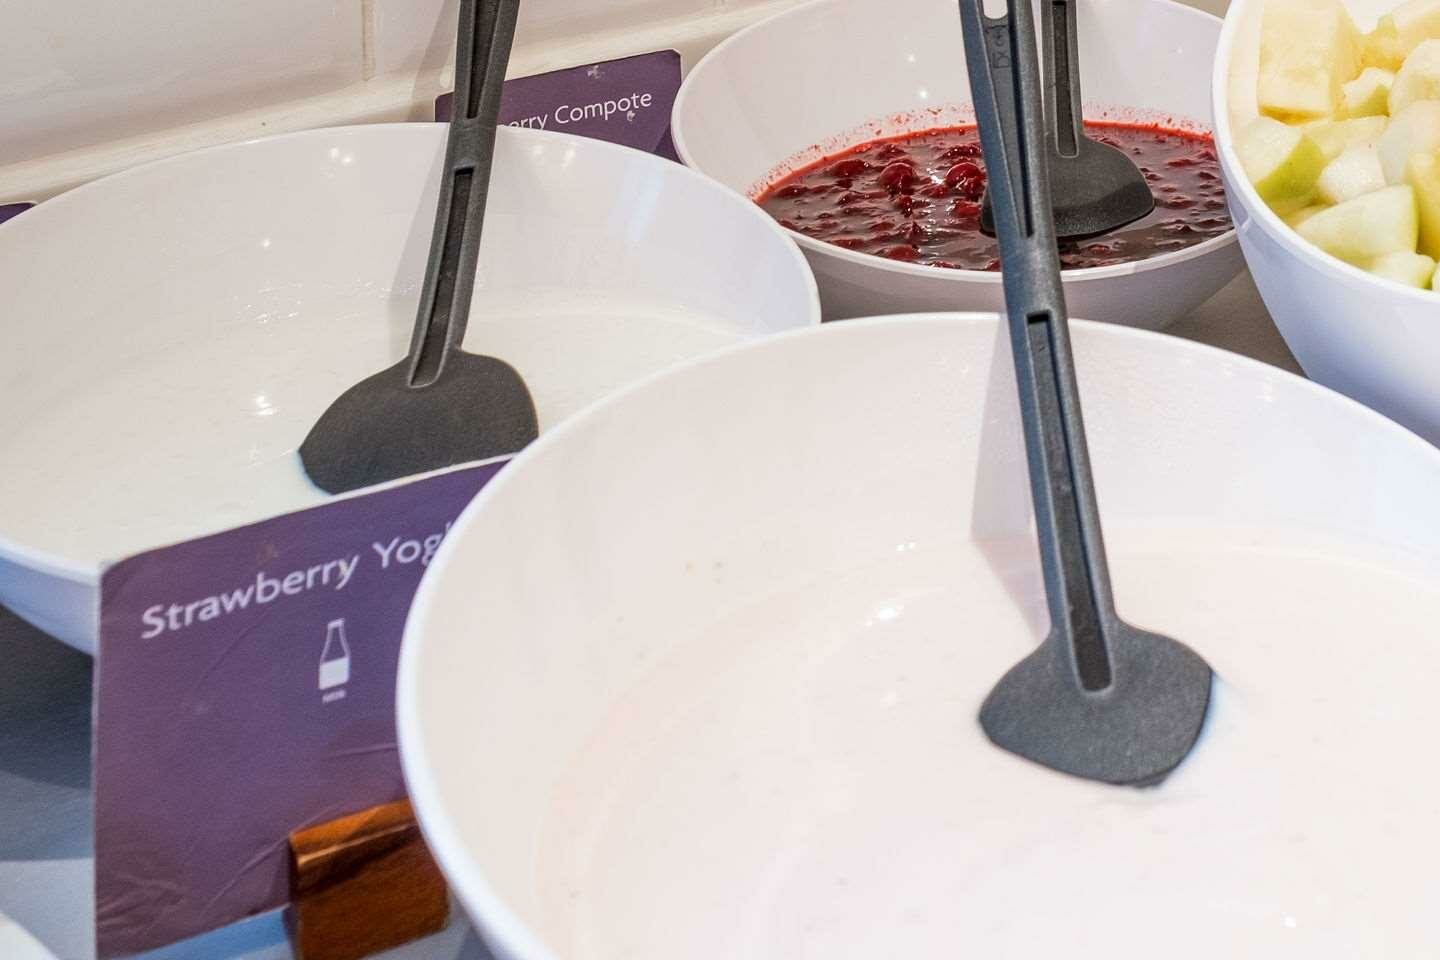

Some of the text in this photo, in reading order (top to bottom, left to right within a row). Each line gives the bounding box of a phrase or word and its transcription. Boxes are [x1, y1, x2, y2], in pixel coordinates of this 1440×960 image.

[555, 93, 652, 124] Compote
[141, 522, 451, 640] Strawberry Yog
